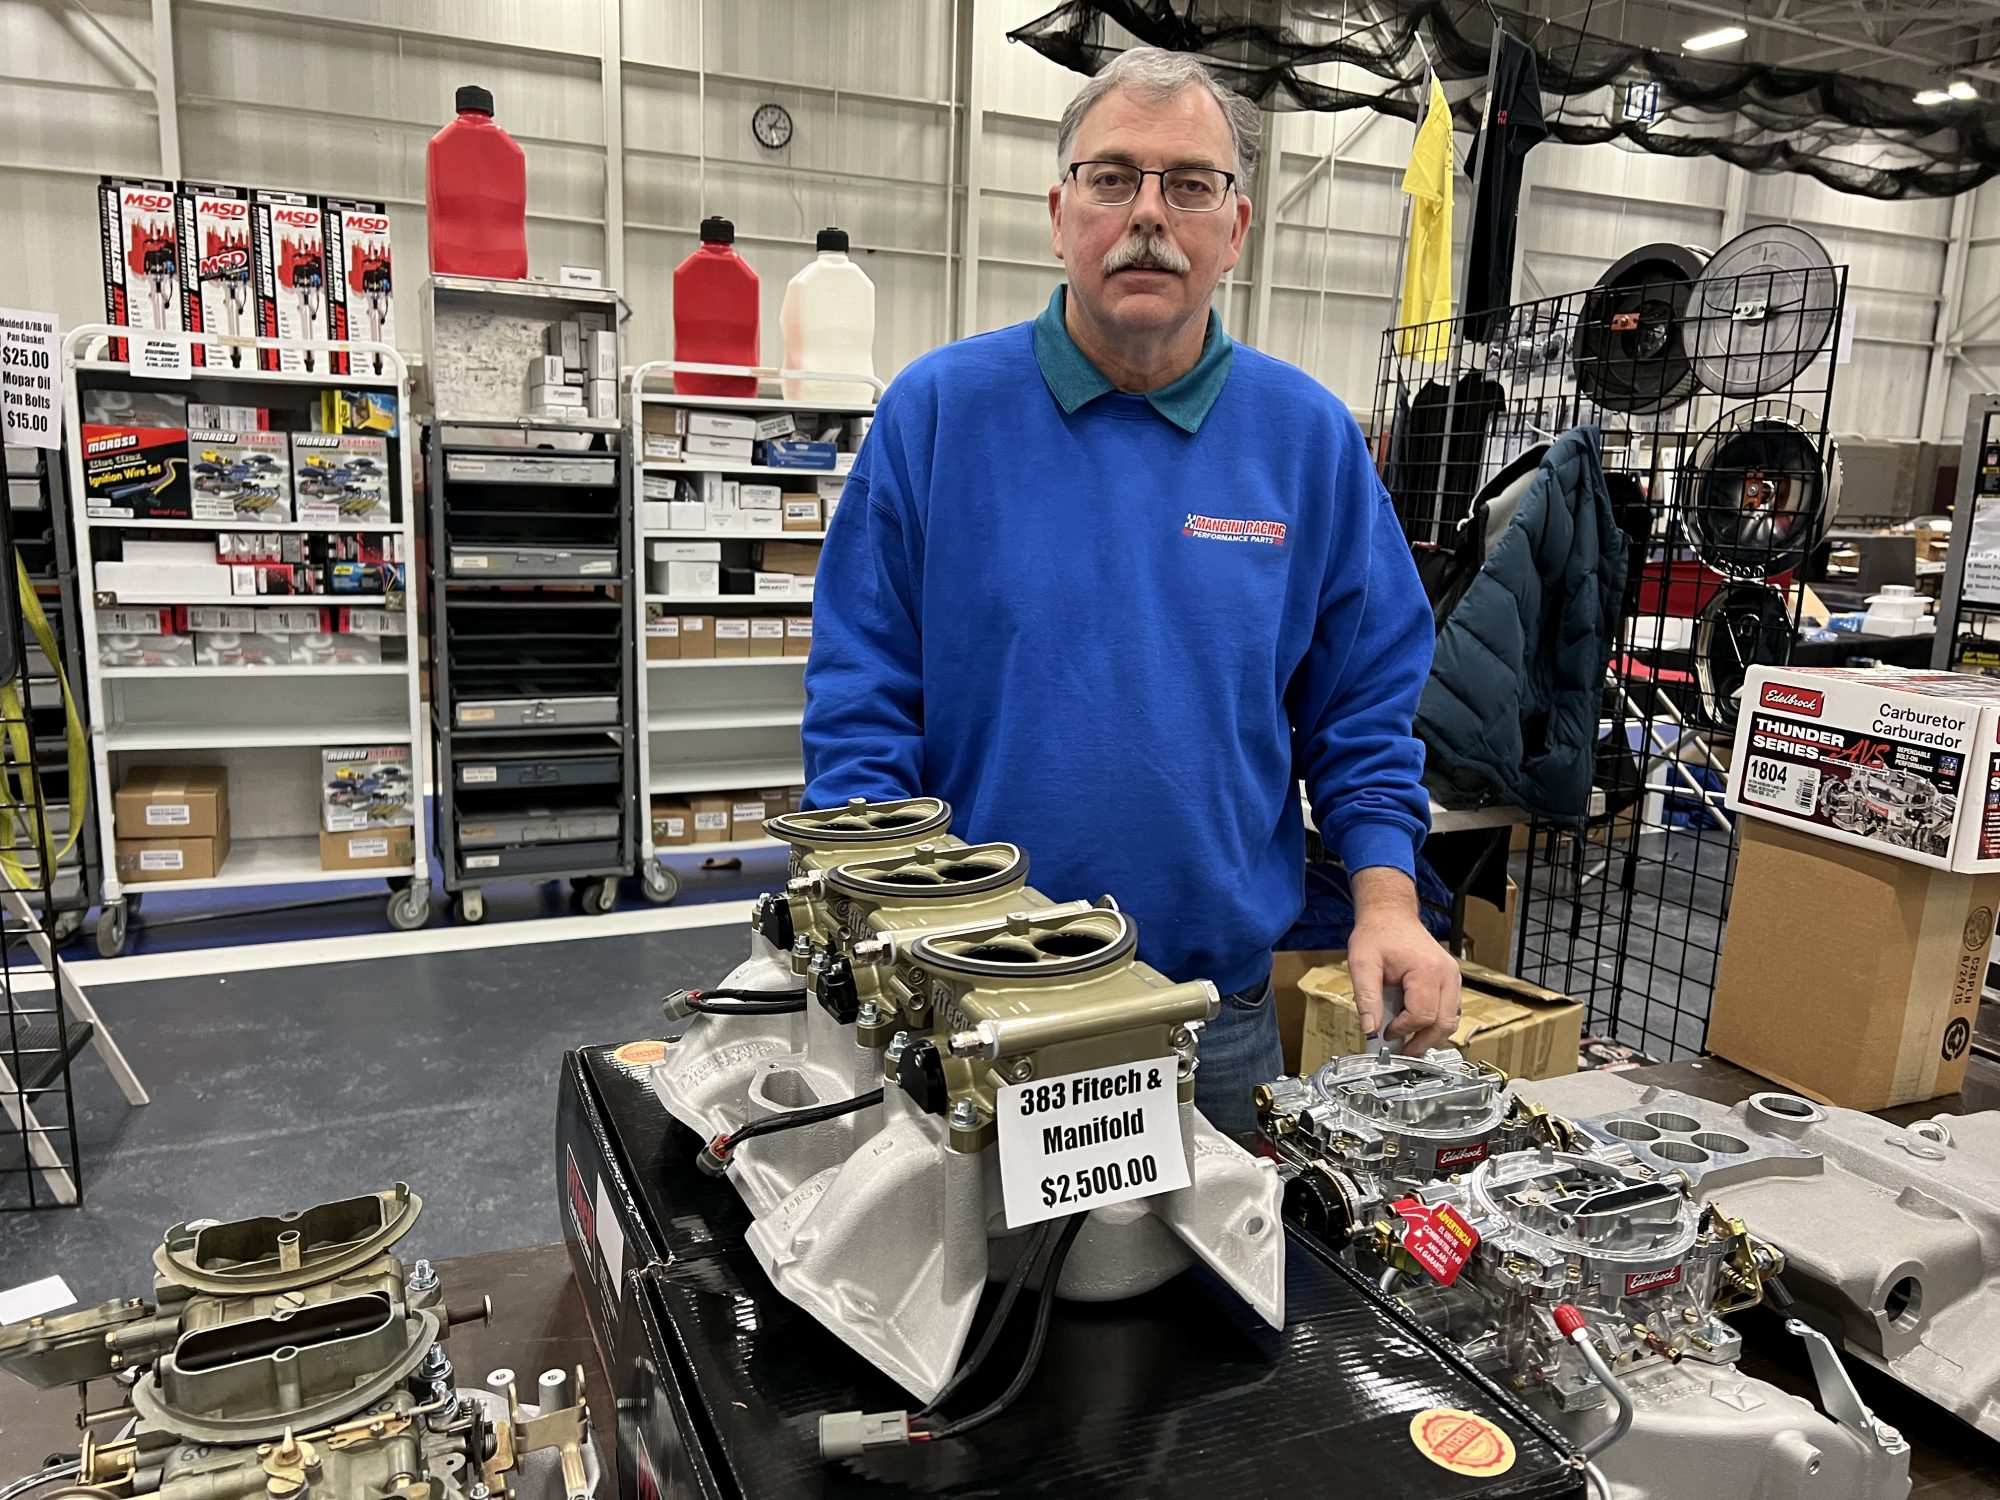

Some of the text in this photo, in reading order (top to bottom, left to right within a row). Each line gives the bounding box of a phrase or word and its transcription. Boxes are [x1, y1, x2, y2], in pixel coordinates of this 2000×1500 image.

[124, 193, 172, 209] MSD
[200, 201, 247, 216] MSD
[275, 210, 318, 224] MSD
[346, 216, 388, 230] MSD
[107, 190, 123, 284] DISTRIBUTOR
[183, 198, 198, 291] DISTRIBUTOR
[201, 251, 247, 276] MSD
[258, 207, 273, 298] DISTRIBUTOR
[330, 213, 344, 302] DISTRIBUTOR
[7, 332, 45, 345] Pan Gasket
[43, 323, 52, 333] Oil
[2, 346, 49, 369] $25.00
[2, 371, 51, 390] Mopar Oil
[3, 390, 51, 409] Pan Bolts
[7, 409, 48, 432] $15.00
[88, 435, 137, 454] MOROSO
[192, 432, 237, 443] MOROSO
[297, 436, 339, 447] MOROSO
[89, 464, 162, 488] Ignition Wire Set
[1193, 530, 1274, 544] PERFORMANCE PARTS
[1195, 515, 1286, 538] MANCINI RACING
[1765, 689, 1817, 711] Edelbrock
[1879, 703, 1966, 731] Carburetor
[1756, 717, 1845, 748] THUNDER
[1872, 719, 1962, 748] Carburador
[327, 749, 367, 761] MOROSO
[1753, 734, 1891, 769] SERIES AVS
[1896, 752, 1919, 763] BOLT-ON
[1897, 746, 1931, 759] DEPENDABLE
[1751, 760, 1787, 784] 1804
[1894, 759, 1934, 773] PERFORMANCE
[1020, 1068, 1162, 1116] 383 Fitech &
[1042, 1108, 1144, 1155] Manifold
[1440, 1147, 1484, 1163] Edelbrock
[1040, 1154, 1158, 1208] $2,500.00
[1437, 1210, 1472, 1247] ADVERTENCIA
[1438, 1226, 1459, 1248] EL USO DE
[1414, 1243, 1424, 1253] LA
[1422, 1225, 1454, 1256] COMBUSTIBLE
[1630, 1270, 1676, 1289] Edelbrock
[1438, 1423, 1482, 1455] PATENTED
[181, 1447, 210, 1461] 60
